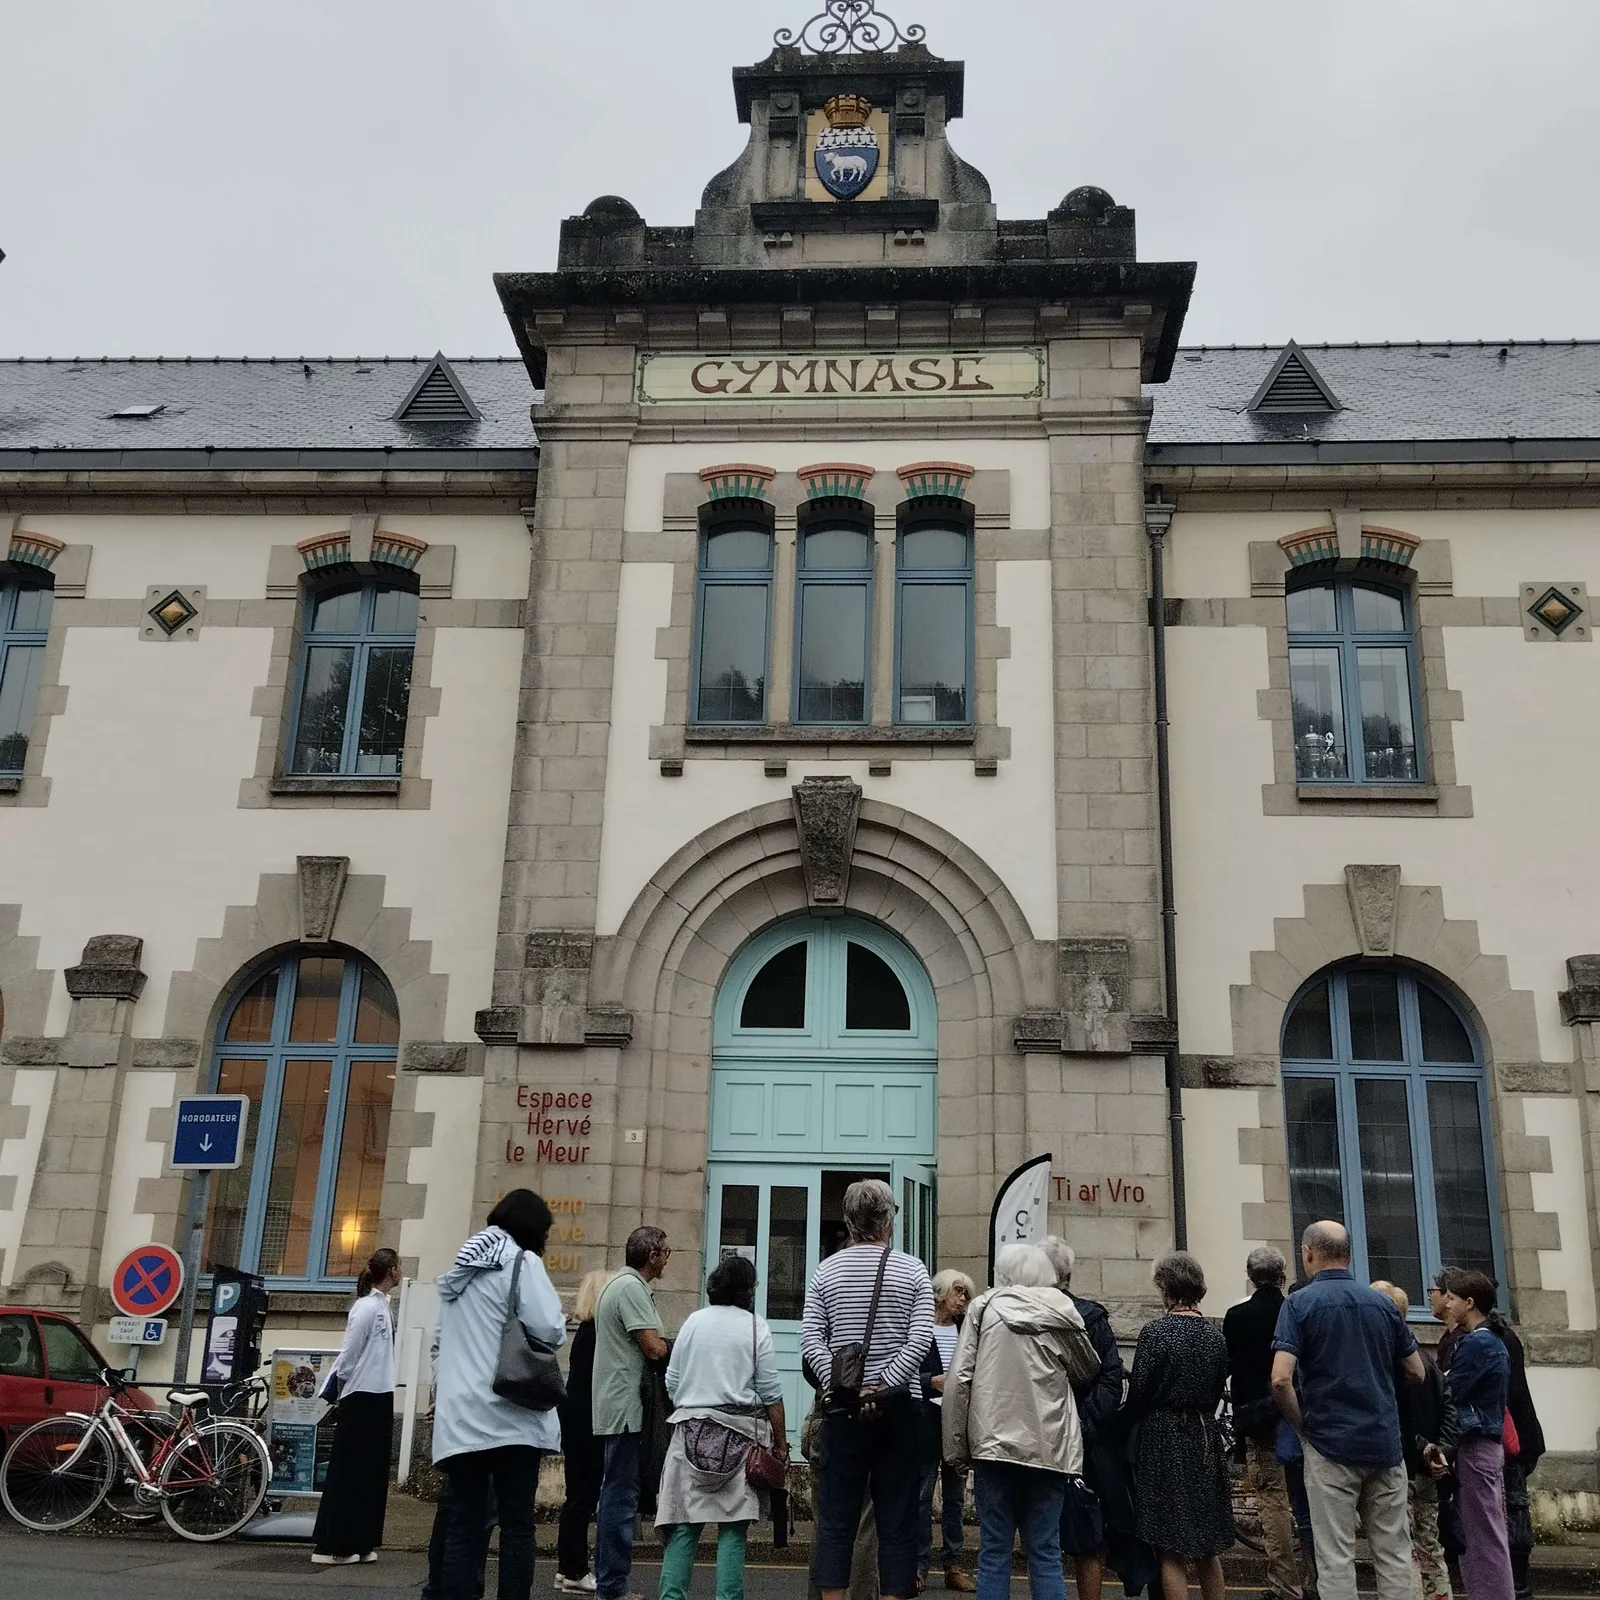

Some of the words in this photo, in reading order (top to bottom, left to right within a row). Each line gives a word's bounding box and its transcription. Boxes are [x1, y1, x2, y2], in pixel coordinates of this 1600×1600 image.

[691, 357, 994, 395] GYMNASE
[516, 1085, 593, 1114] Espace
[181, 1114, 237, 1122] HORODATEUR
[527, 1111, 592, 1136] Hervé
[630, 1132, 638, 1141] 3
[505, 1139, 525, 1163] le
[536, 1139, 590, 1164] Meur
[1052, 1176, 1071, 1201] Ti
[1078, 1183, 1100, 1202] ar
[1107, 1177, 1145, 1203] Vro
